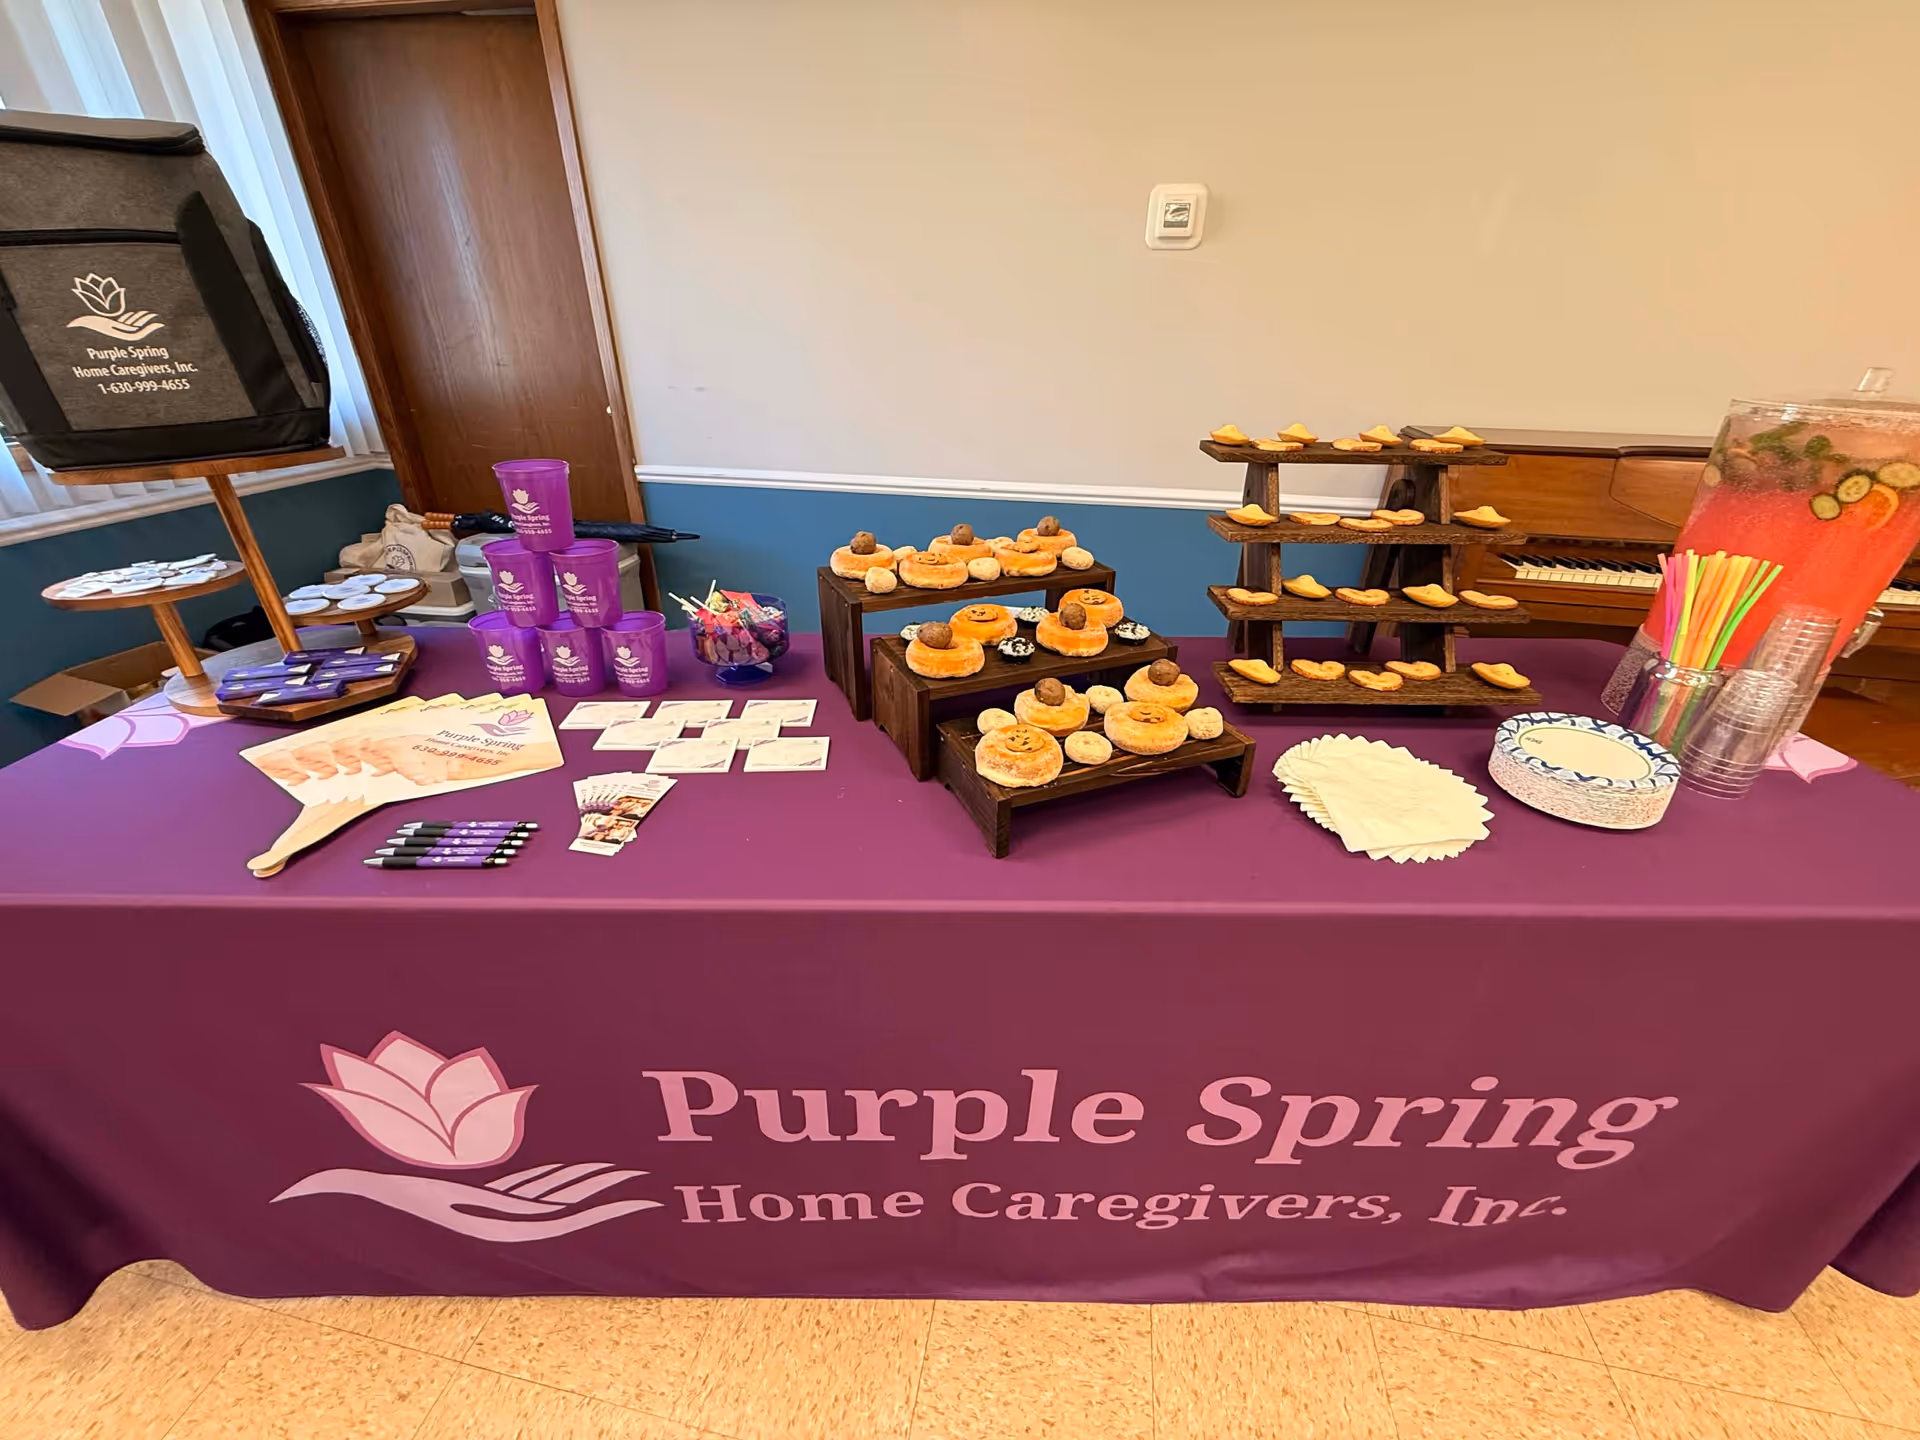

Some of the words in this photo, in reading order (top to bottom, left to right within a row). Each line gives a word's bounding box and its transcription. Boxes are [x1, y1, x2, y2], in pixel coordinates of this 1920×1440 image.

[87, 347, 128, 361] Purple
[128, 346, 170, 360] Spring
[72, 366, 111, 378] Home
[110, 363, 176, 378] Caregivers,
[174, 361, 199, 373] Inc.
[97, 378, 191, 394] 1-630-999-4655
[436, 729, 481, 744] Purple
[480, 737, 526, 752] Spring
[411, 744, 503, 767] 630-999-4655
[641, 1068, 1145, 1161] Purple
[1186, 1075, 1679, 1170] Spring
[673, 1184, 925, 1223] Home
[951, 1182, 1403, 1230] Caregivers,
[1428, 1185, 1568, 1227] Inc.
